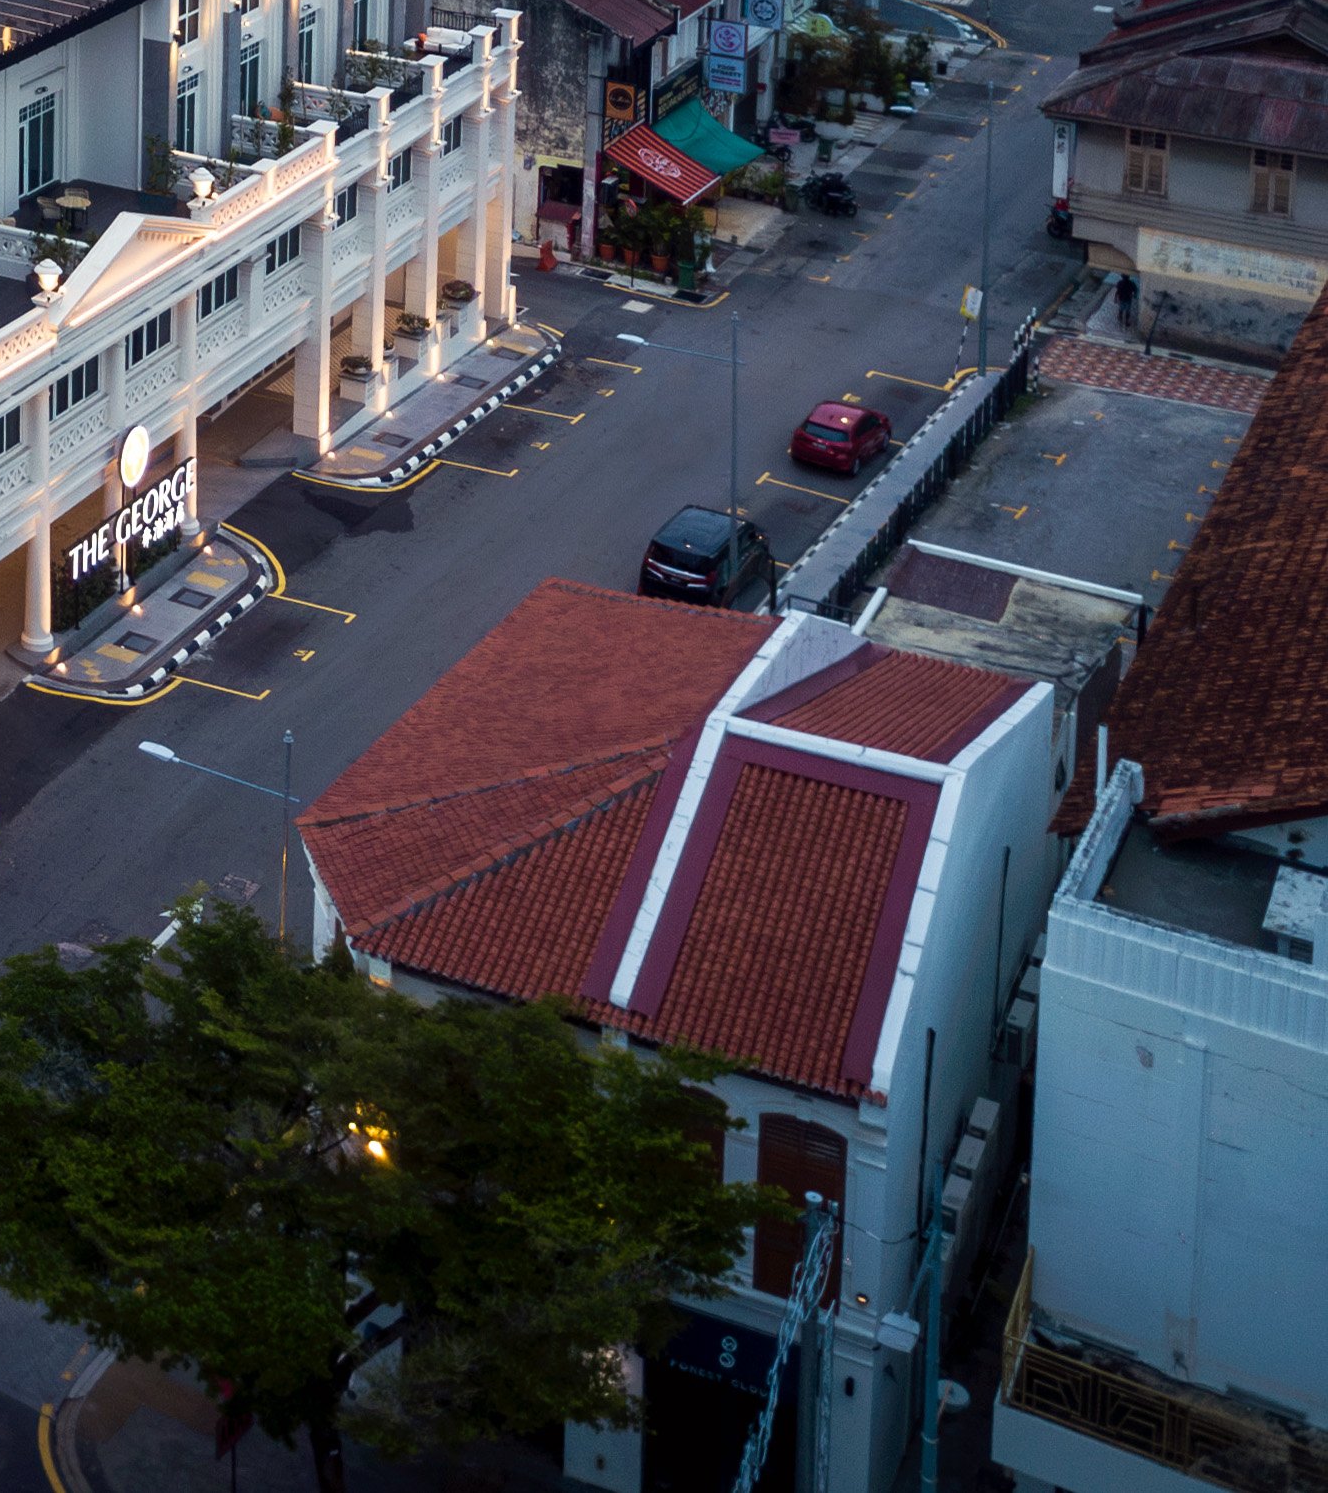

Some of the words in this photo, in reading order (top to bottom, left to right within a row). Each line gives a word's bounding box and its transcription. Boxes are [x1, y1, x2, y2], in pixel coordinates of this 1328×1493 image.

[68, 522, 111, 581] THE
[115, 457, 197, 544] GEORGE
[731, 1379, 773, 1398] CLOU
